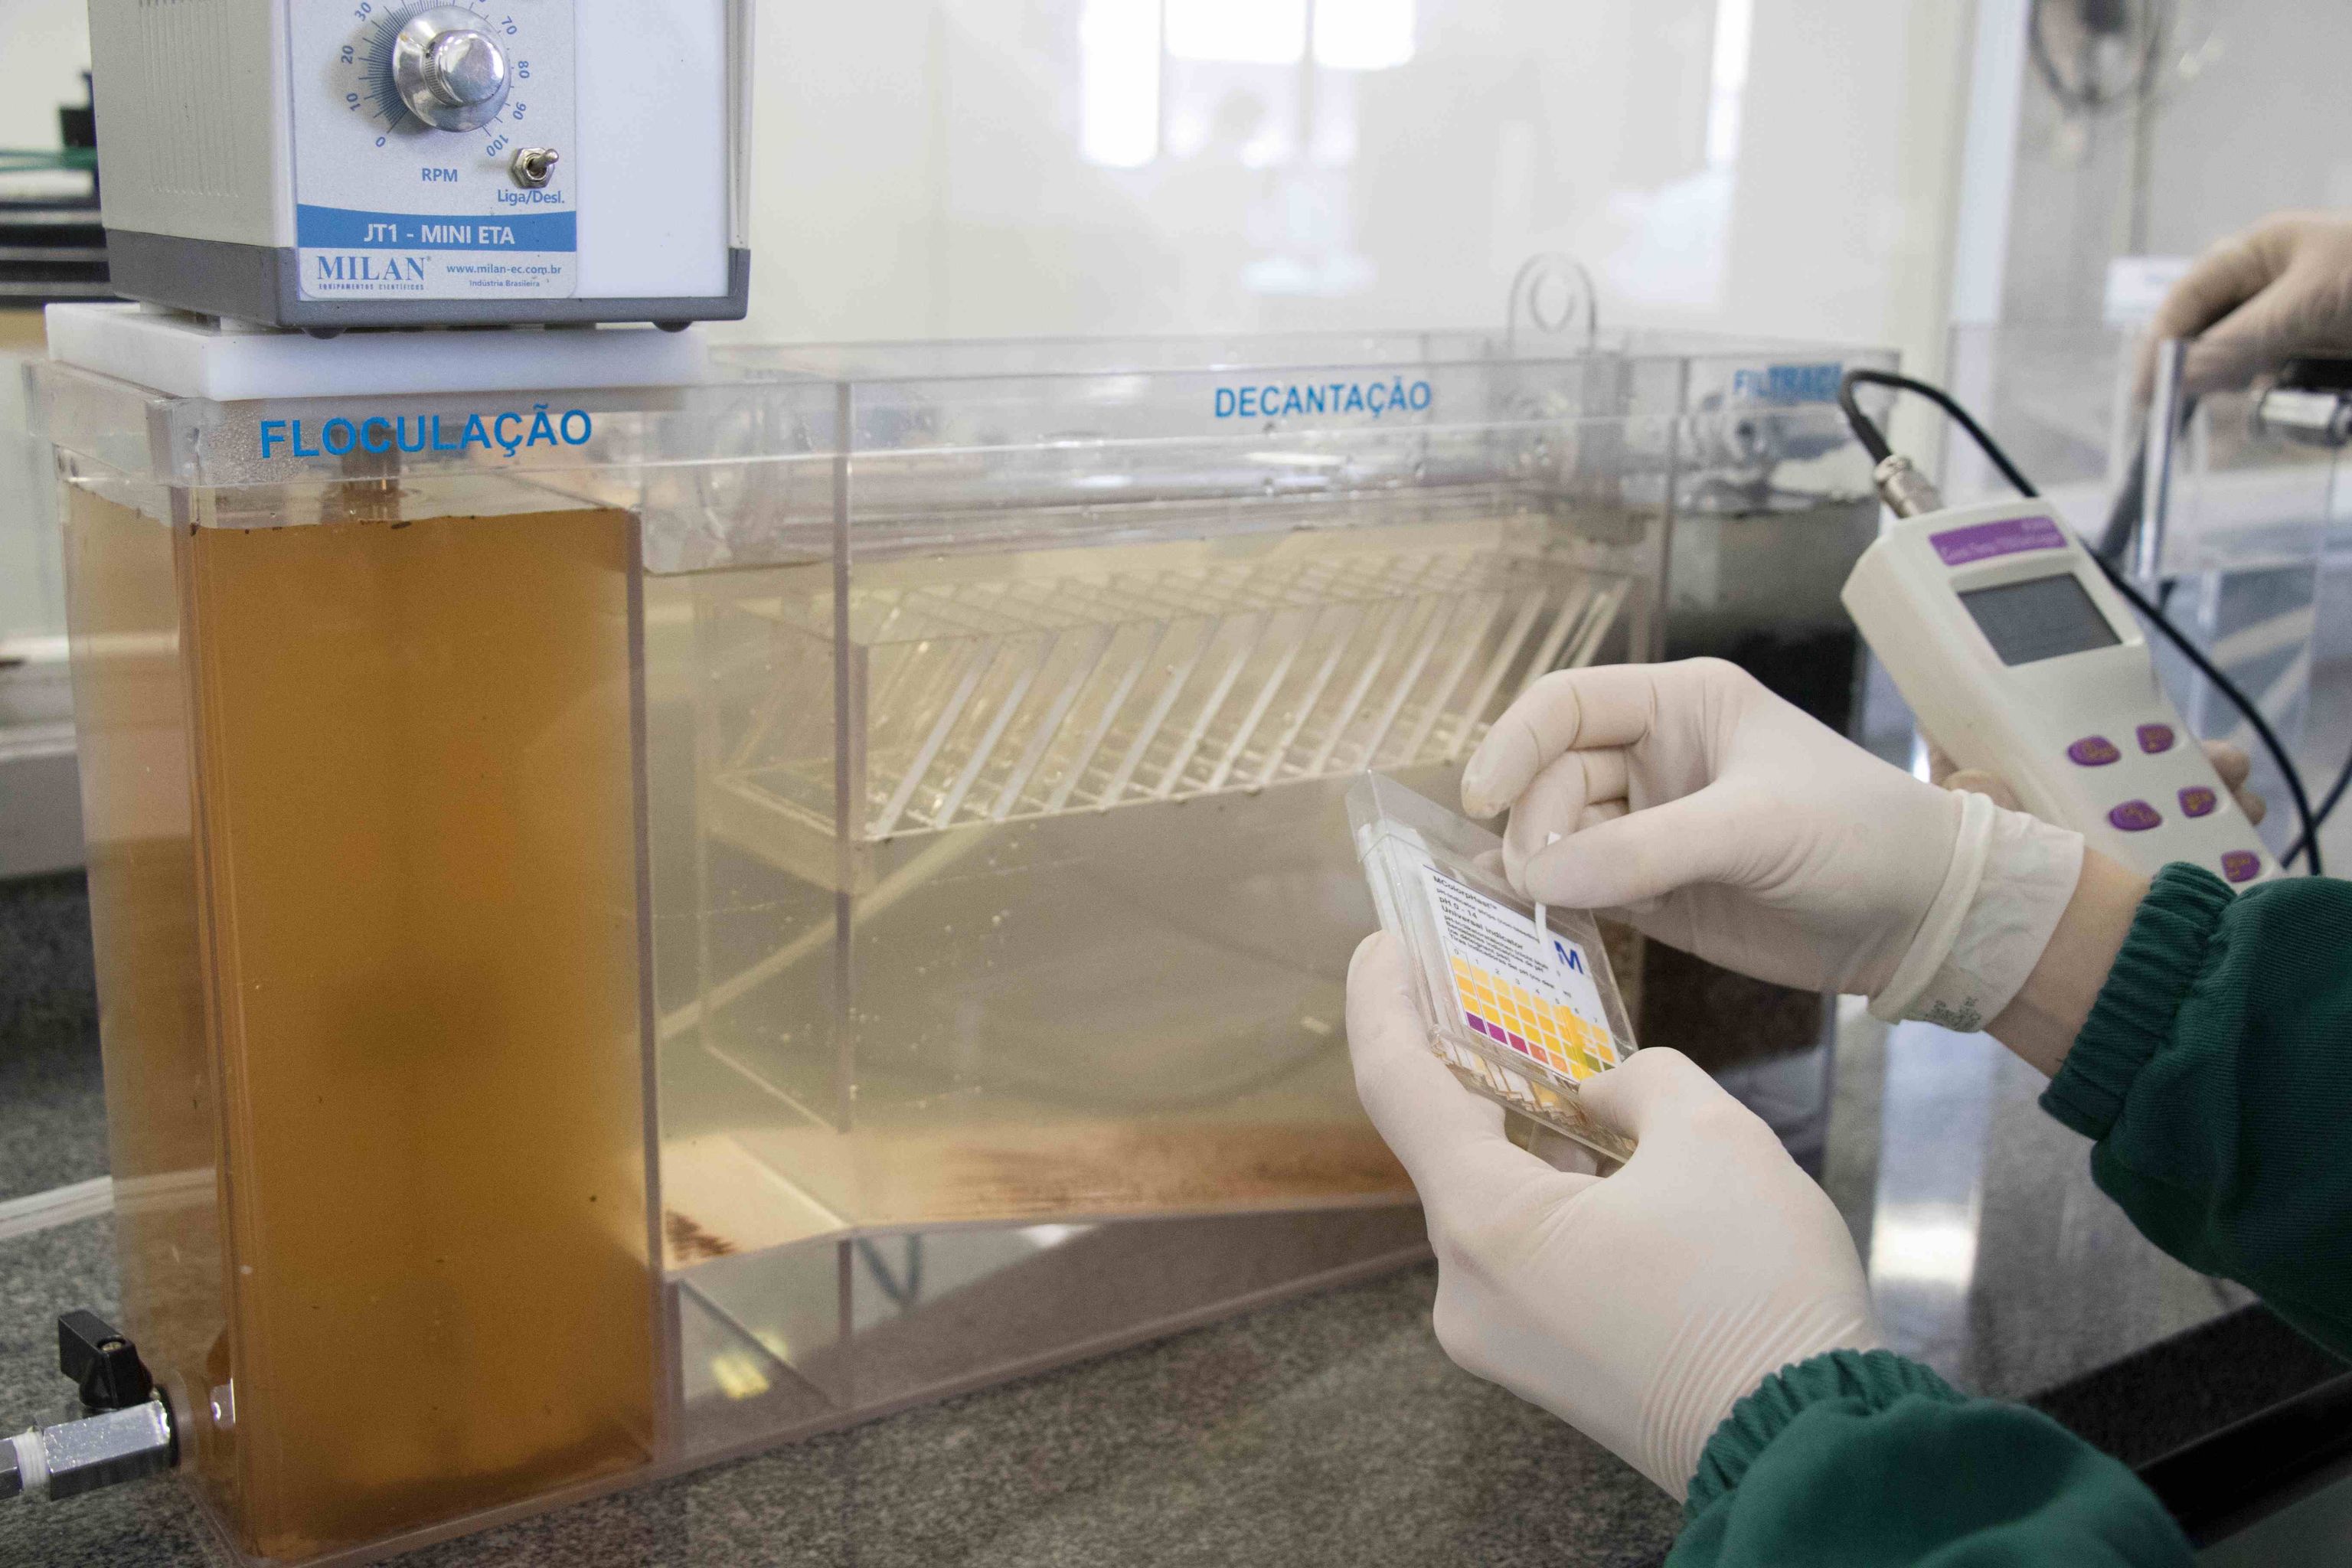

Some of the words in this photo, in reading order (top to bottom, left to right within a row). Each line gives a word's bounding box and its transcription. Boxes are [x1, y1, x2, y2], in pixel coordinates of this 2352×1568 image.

[354, 2, 372, 21] 30
[501, 15, 518, 35] 70
[341, 45, 354, 64] 20
[518, 60, 530, 79] 80
[346, 93, 361, 112] 10
[512, 102, 527, 120] 90
[375, 136, 386, 148] 0
[486, 135, 509, 157] 100
[422, 168, 458, 182] RPM
[498, 189, 564, 206] Liga/Desl.
[364, 223, 397, 243] JT1
[422, 224, 472, 243] MINI
[479, 226, 515, 245] ETA
[317, 256, 425, 281] MILAN
[446, 263, 562, 276] www.milan-ec.com.br
[1215, 375, 1432, 419] DECANTAÇÃO
[260, 403, 593, 459] FLOCULAÇÃO
[1439, 897, 1451, 905] pH
[1553, 940, 1583, 974] M
